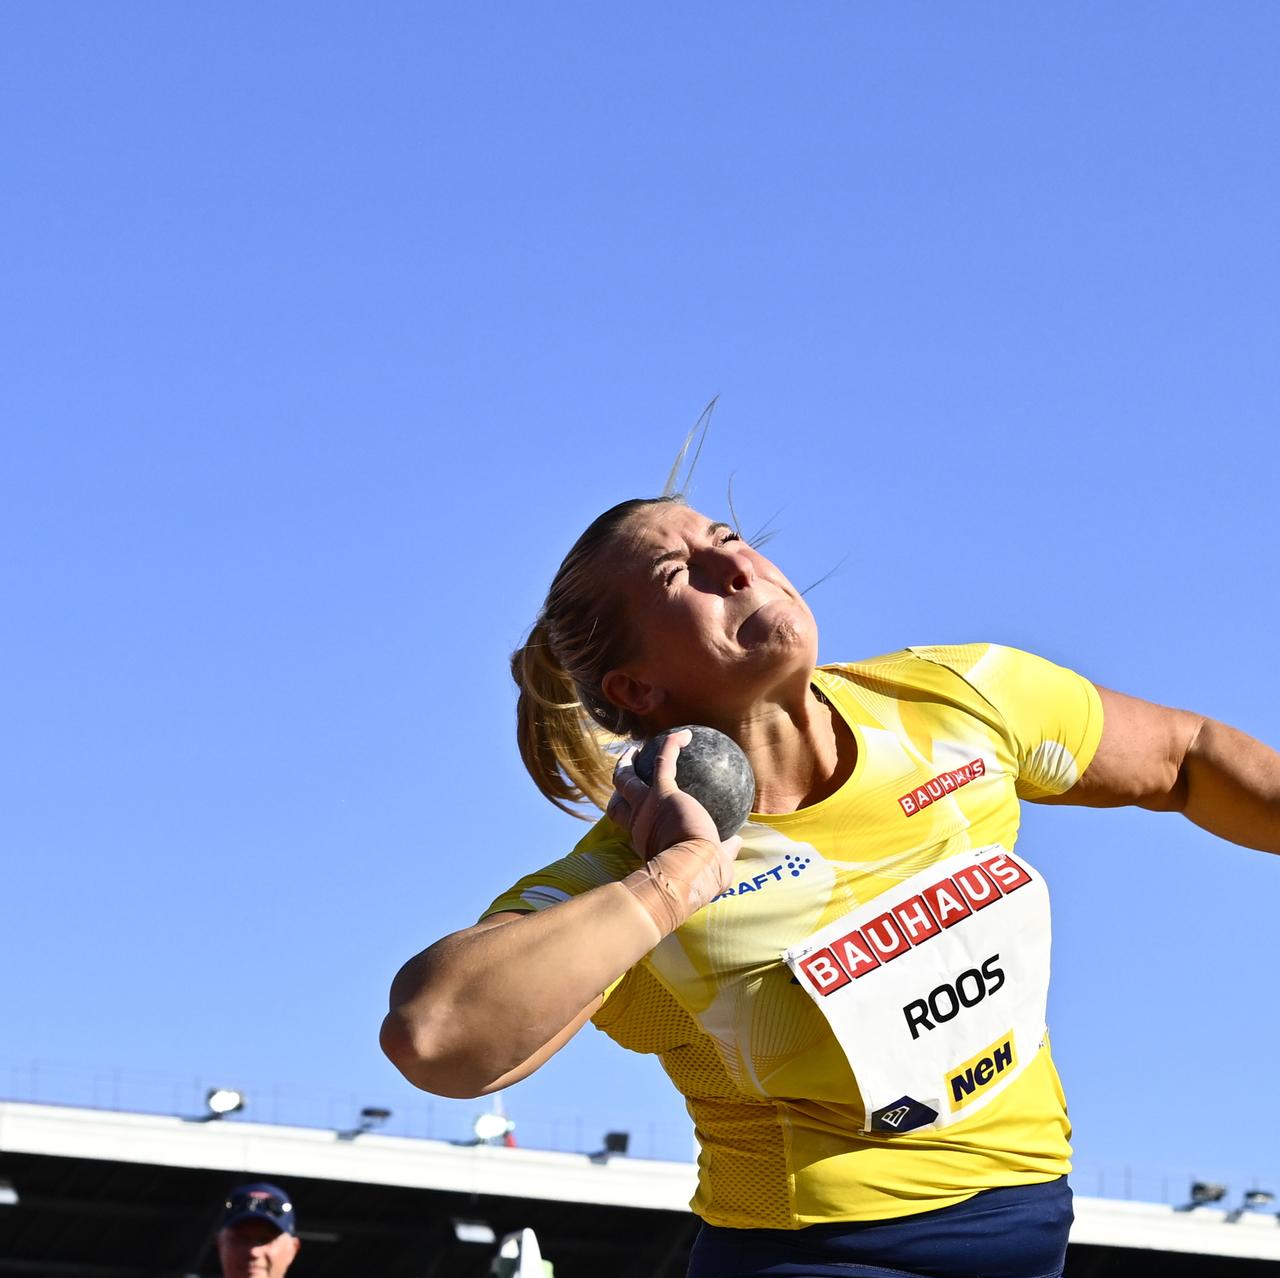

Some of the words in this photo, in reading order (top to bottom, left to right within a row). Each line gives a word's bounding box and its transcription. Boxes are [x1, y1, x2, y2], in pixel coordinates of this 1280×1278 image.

[710, 864, 783, 903] RAFT
[805, 856, 1021, 990] BAUHAUS
[902, 953, 1006, 1041] ROOS
